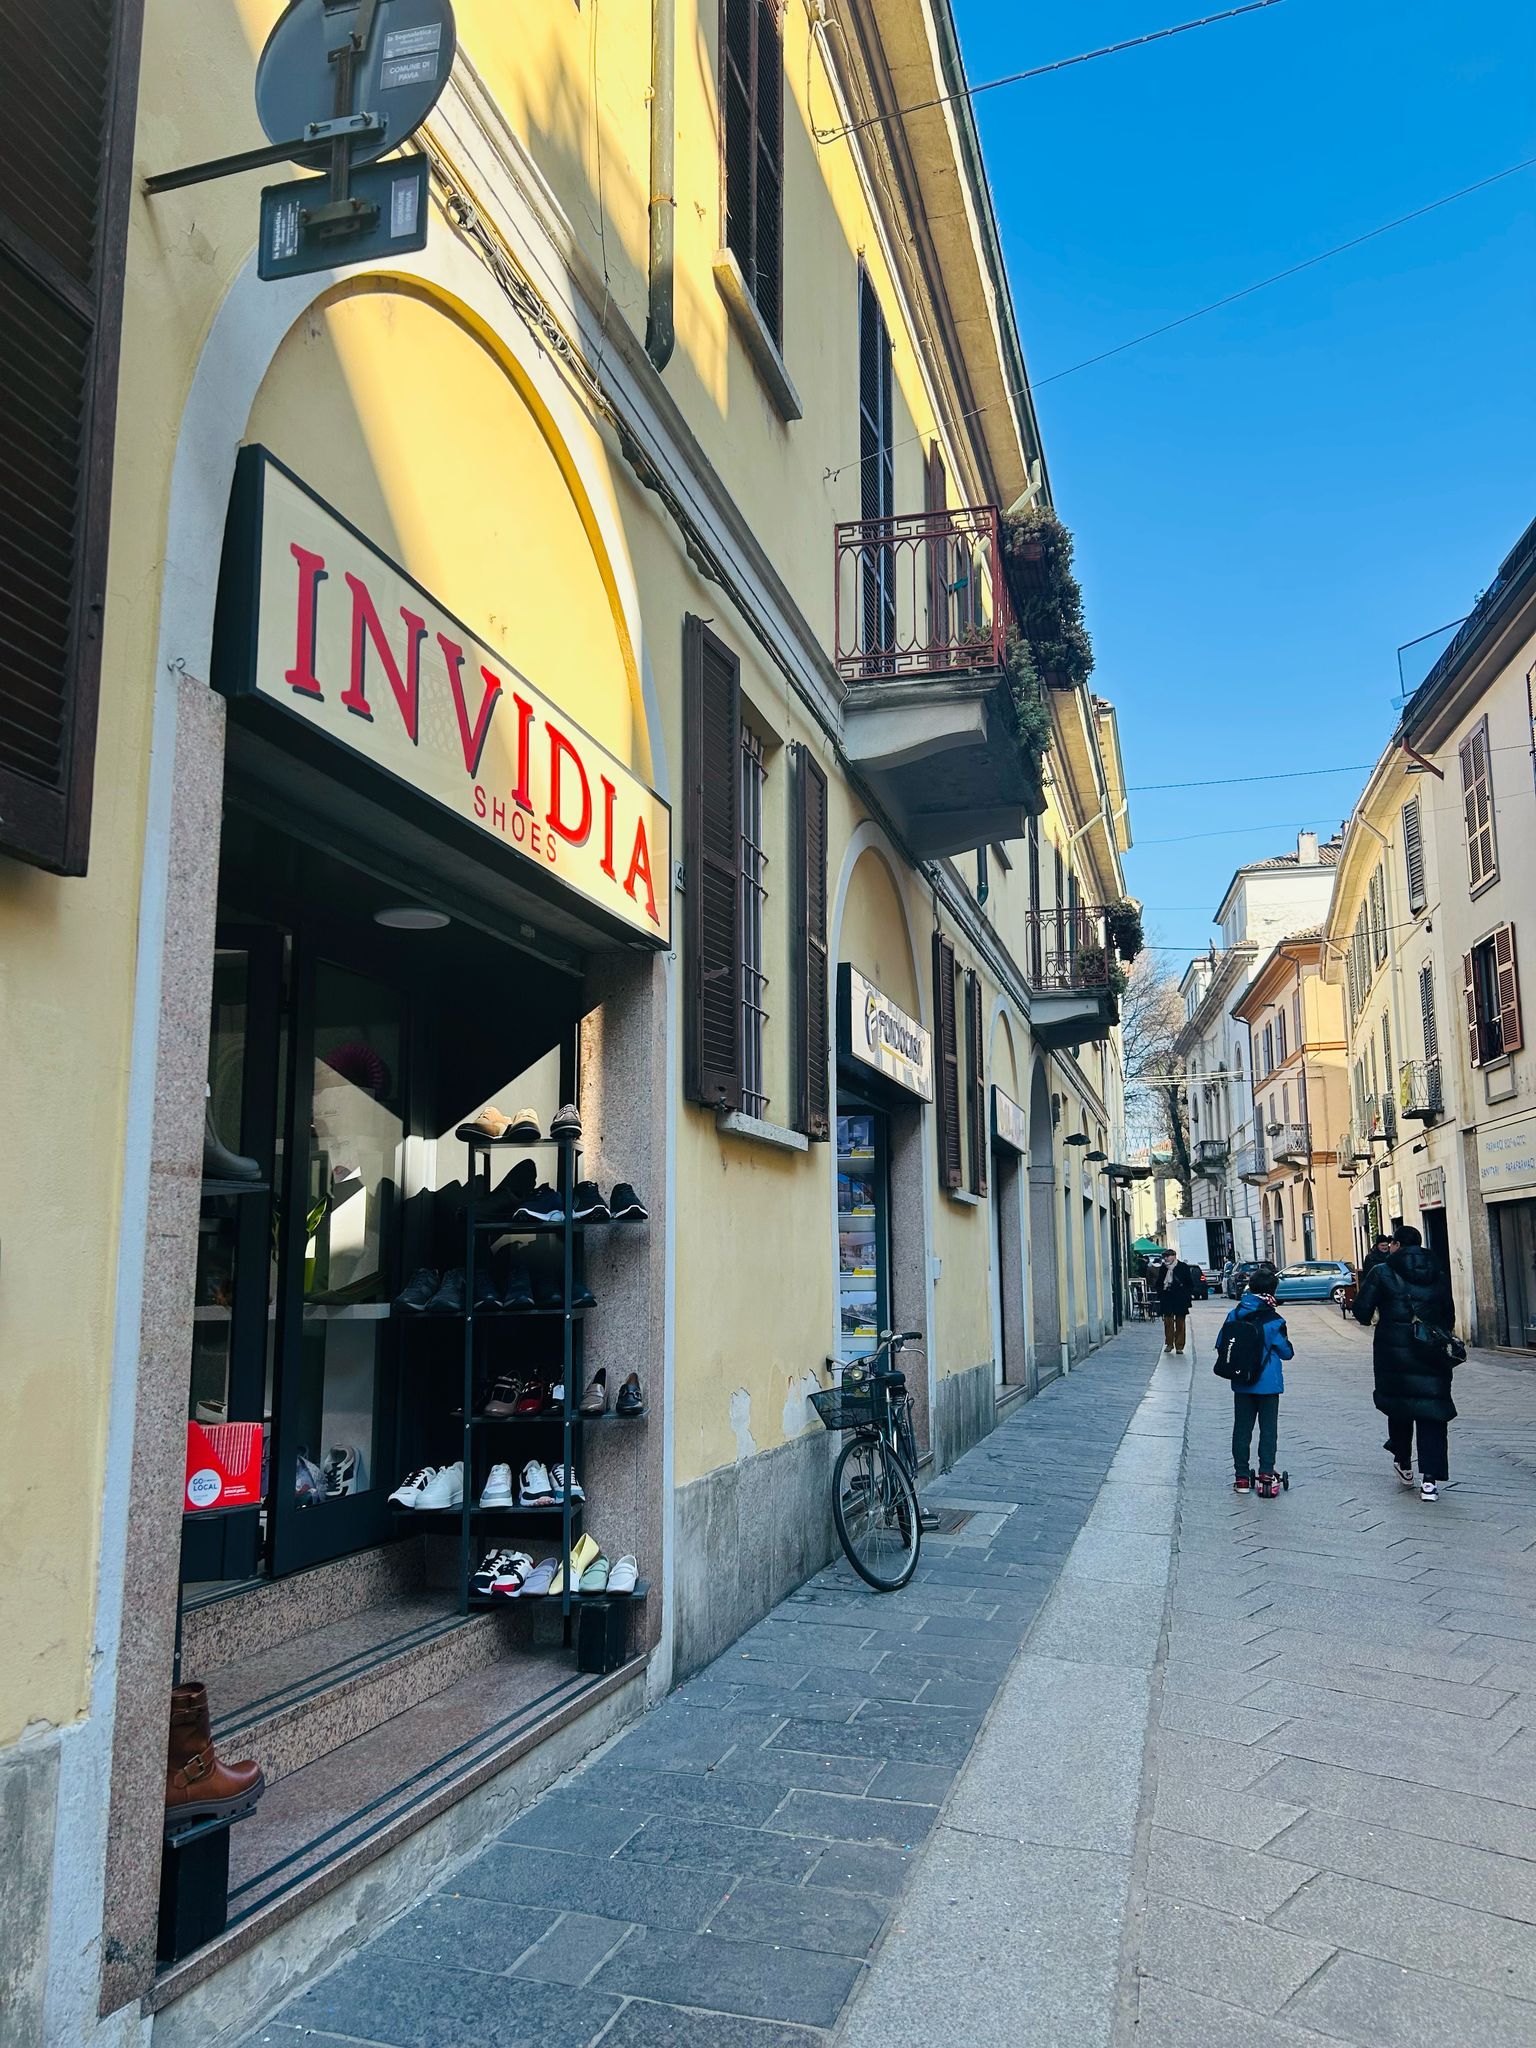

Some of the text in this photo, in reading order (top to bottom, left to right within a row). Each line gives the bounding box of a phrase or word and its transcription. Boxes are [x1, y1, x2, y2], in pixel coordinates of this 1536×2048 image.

[389, 60, 430, 74] COMUNE DI
[398, 71, 419, 81] PAVIA
[285, 542, 660, 926] INVIDIA
[473, 784, 557, 863] SHOES
